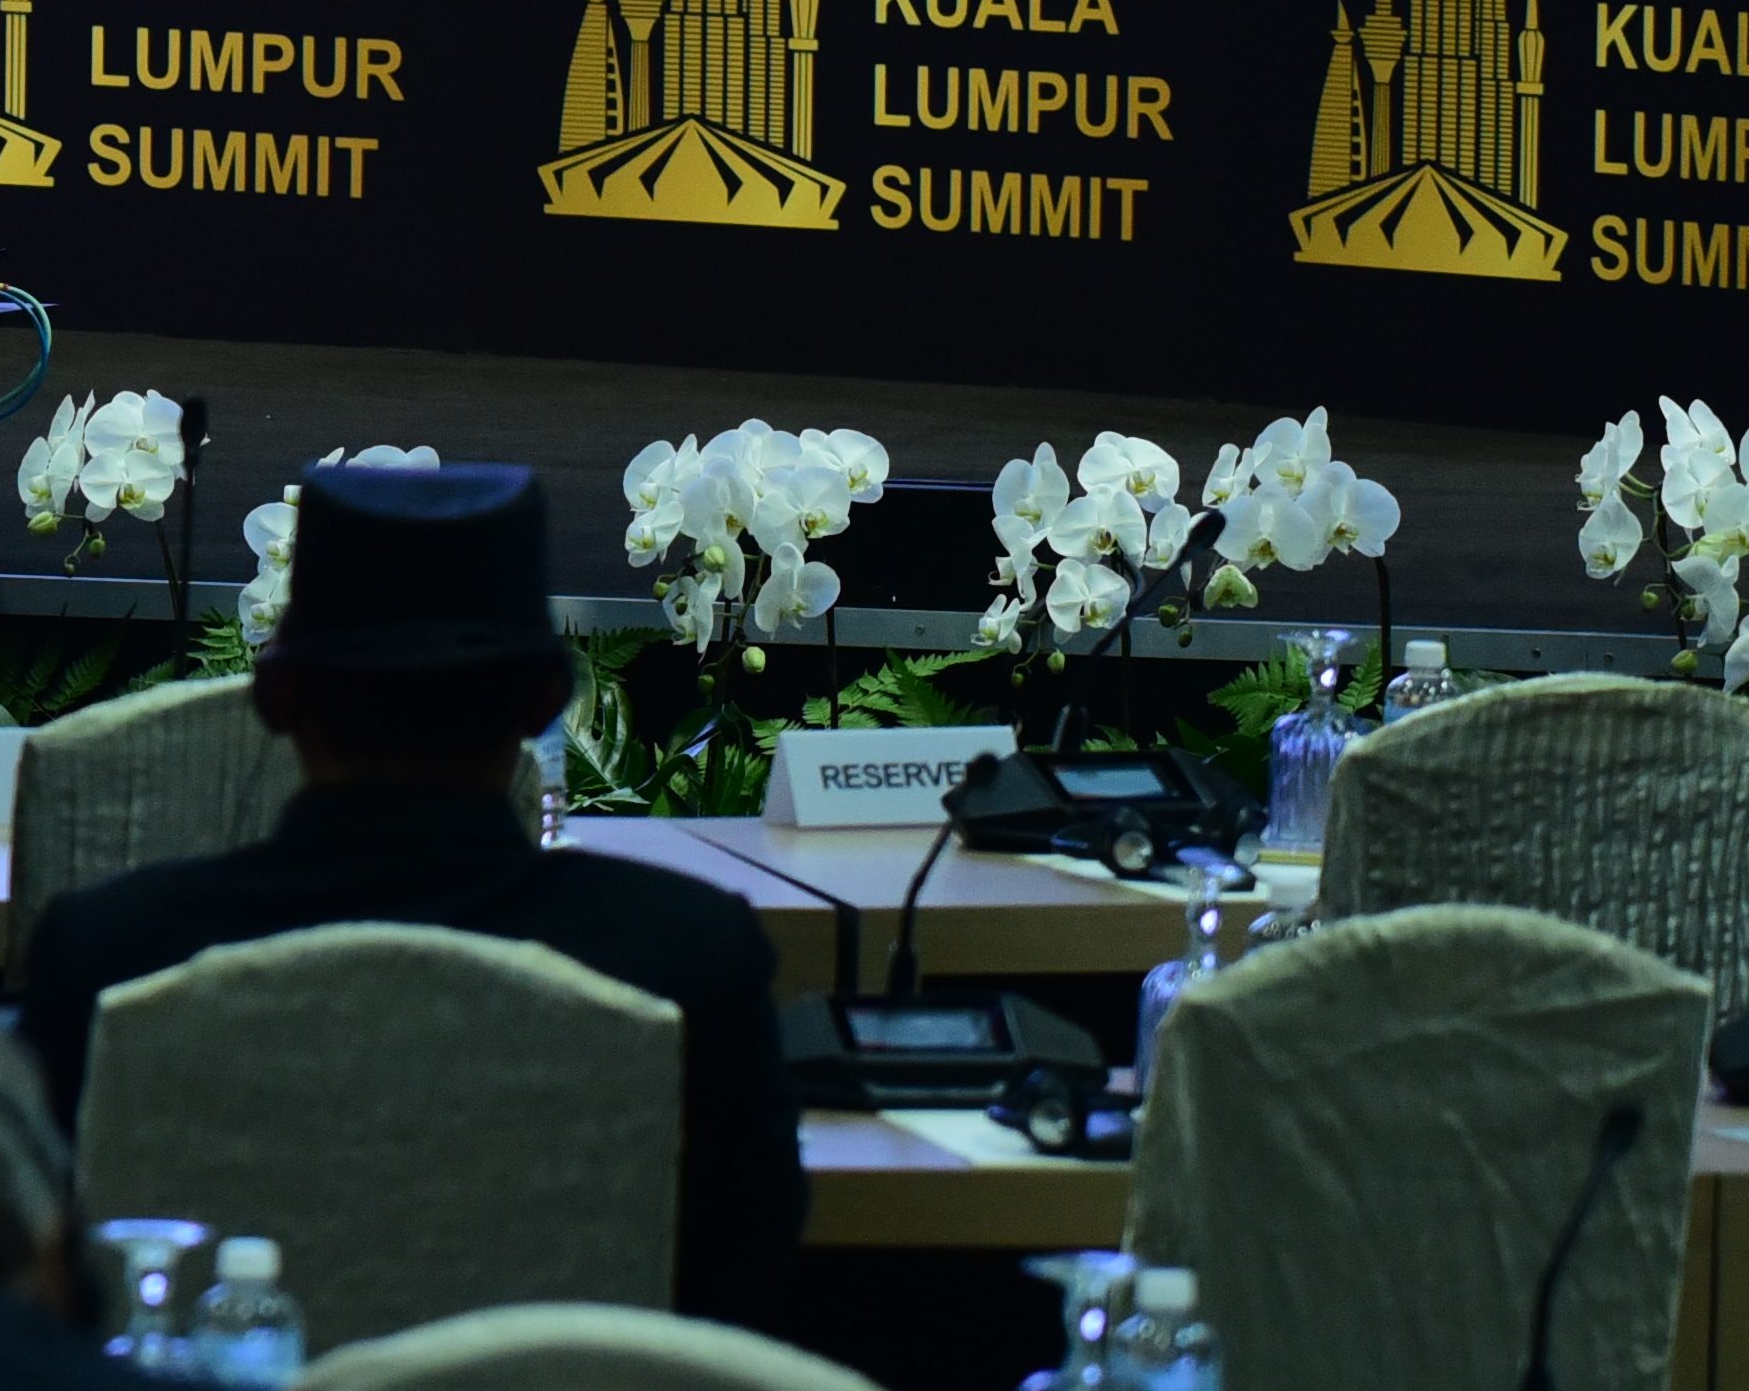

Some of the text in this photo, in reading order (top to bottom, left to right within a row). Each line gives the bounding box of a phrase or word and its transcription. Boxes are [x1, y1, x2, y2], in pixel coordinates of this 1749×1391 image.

[90, 26, 404, 101] LUMPUR
[1596, 3, 1749, 77] KUAL
[873, 65, 1173, 140] LUMPUR
[86, 125, 379, 198] SUMMIT
[1593, 110, 1749, 183] LUM
[869, 165, 1149, 241] SUMMIT
[1590, 215, 1749, 290] SUM
[821, 762, 964, 790] RESERVE
